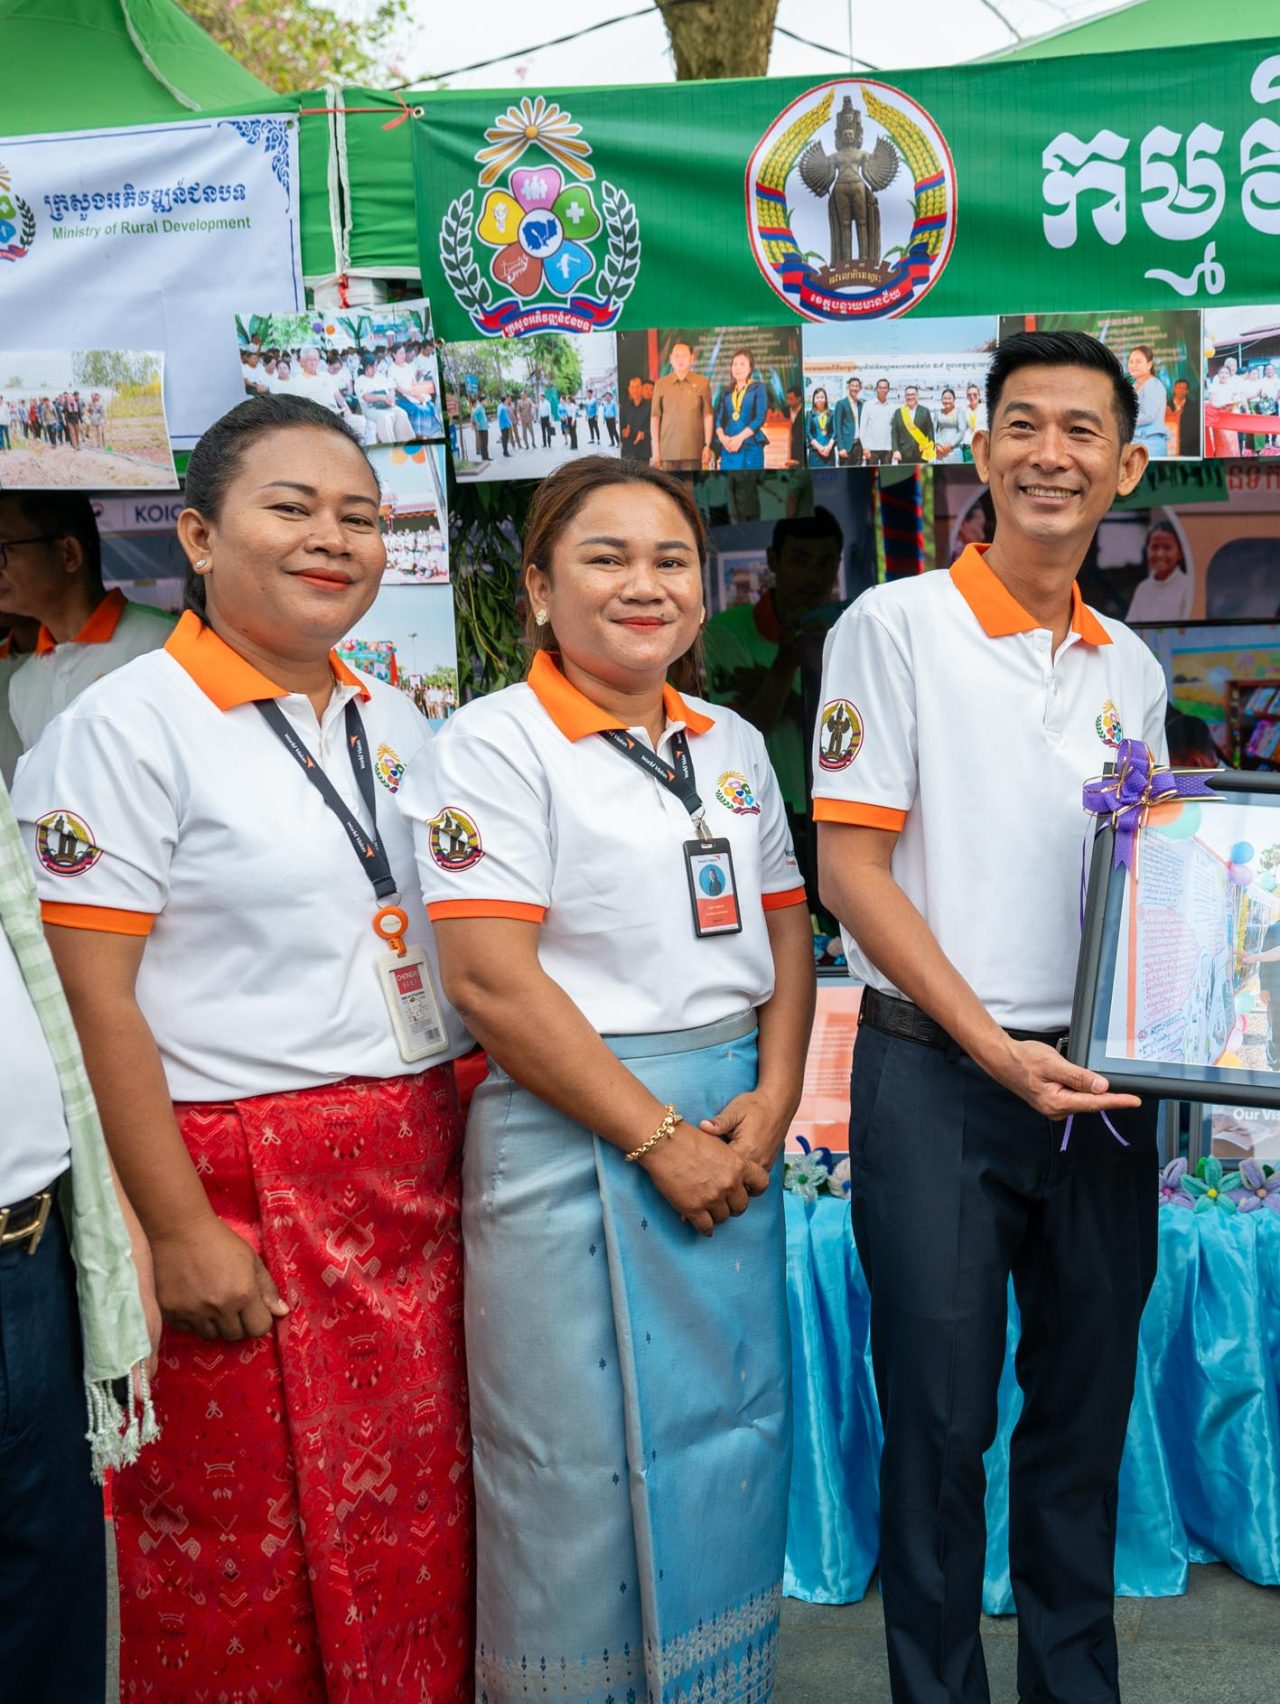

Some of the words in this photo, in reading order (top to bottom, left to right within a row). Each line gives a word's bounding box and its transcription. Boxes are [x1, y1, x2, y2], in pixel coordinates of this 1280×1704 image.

[52, 225, 101, 240] Ministry
[105, 221, 117, 235] of
[121, 220, 158, 235] Rural
[163, 216, 251, 233] Development
[135, 504, 184, 523] KOIC
[641, 755, 656, 768] World
[655, 766, 668, 779] Vision
[1233, 1108, 1260, 1120] Our
